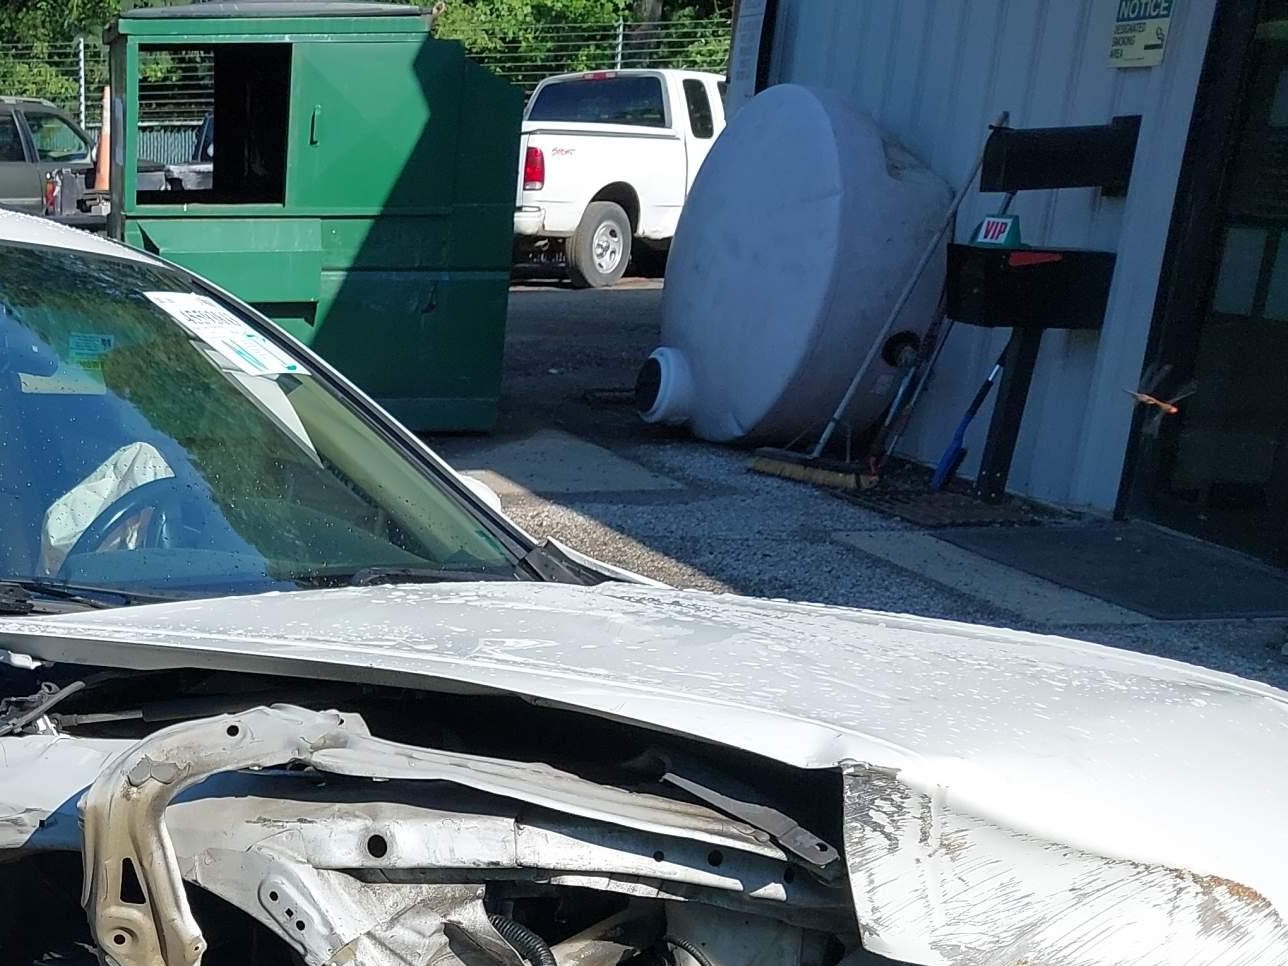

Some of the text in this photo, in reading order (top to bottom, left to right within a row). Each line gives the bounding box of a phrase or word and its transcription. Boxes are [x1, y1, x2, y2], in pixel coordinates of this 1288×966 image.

[1118, 0, 1169, 19] NOTICE
[1112, 35, 1136, 47] SMOKING
[1109, 48, 1123, 59] AREA
[983, 220, 1008, 240] VIP
